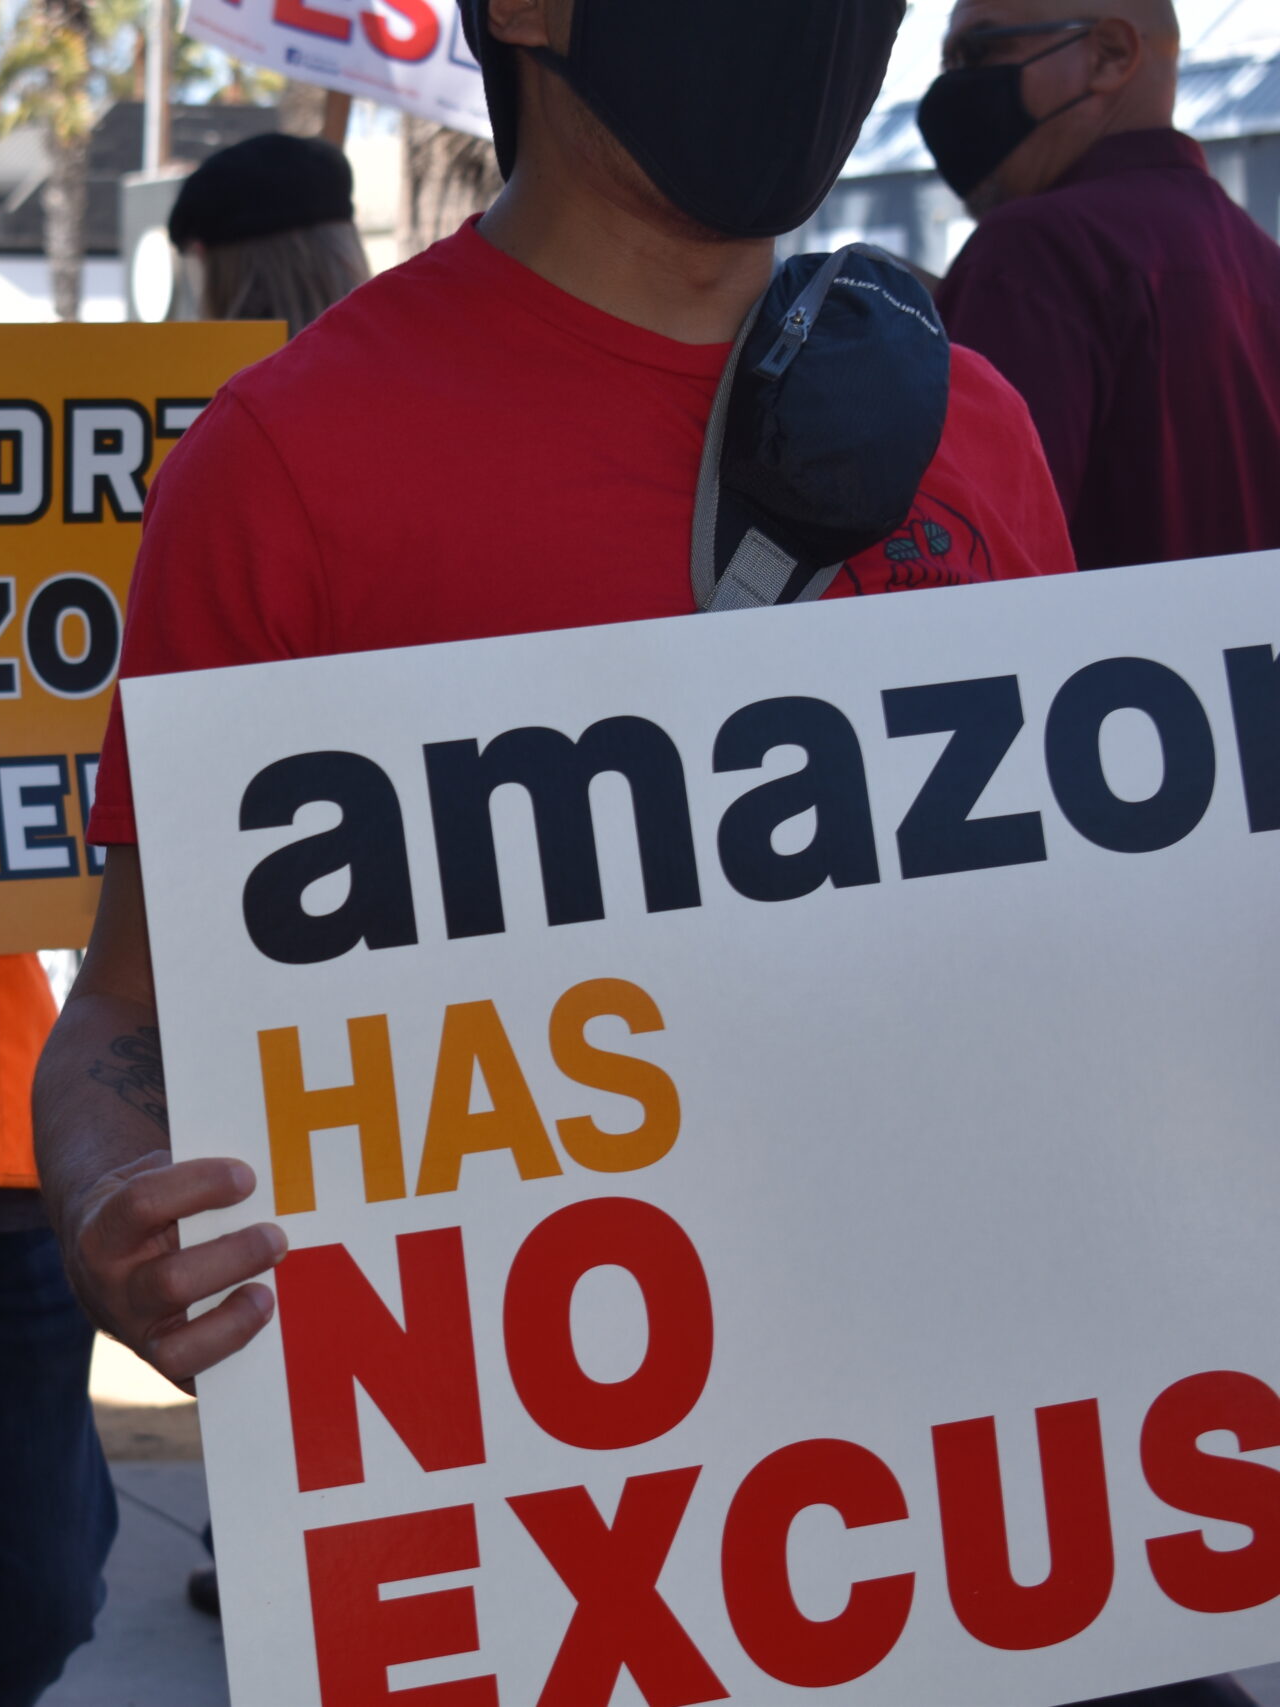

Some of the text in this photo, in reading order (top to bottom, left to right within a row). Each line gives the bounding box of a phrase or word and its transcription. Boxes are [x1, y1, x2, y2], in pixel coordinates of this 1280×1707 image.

[257, 977, 681, 1216] HAS
[272, 1196, 715, 1494] NO
[303, 1370, 1280, 1707] EXCUS
